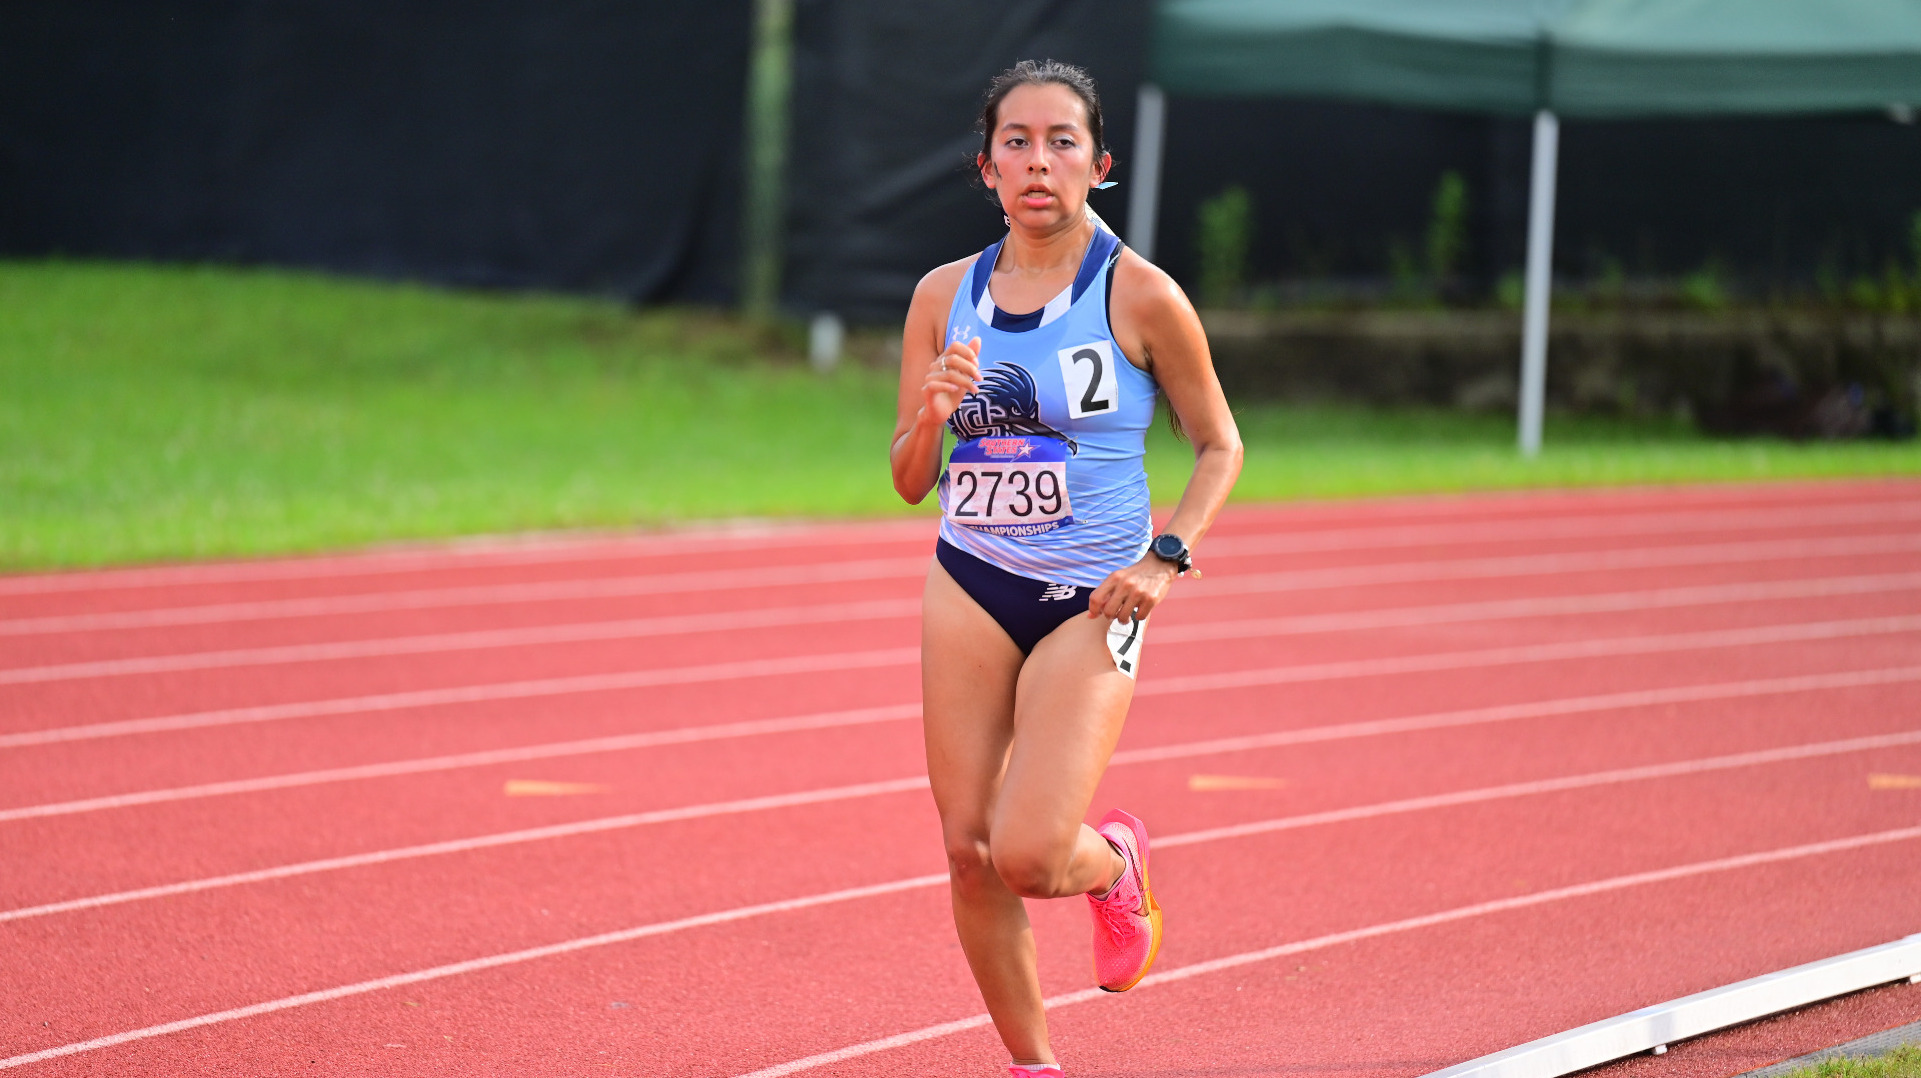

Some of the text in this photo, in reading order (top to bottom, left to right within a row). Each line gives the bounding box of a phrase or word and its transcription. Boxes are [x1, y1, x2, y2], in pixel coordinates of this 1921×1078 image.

[1071, 348, 1109, 413] 2
[979, 438, 1025, 447] SOUTHERN
[985, 446, 1018, 455] STATES
[954, 471, 1062, 517] 2739
